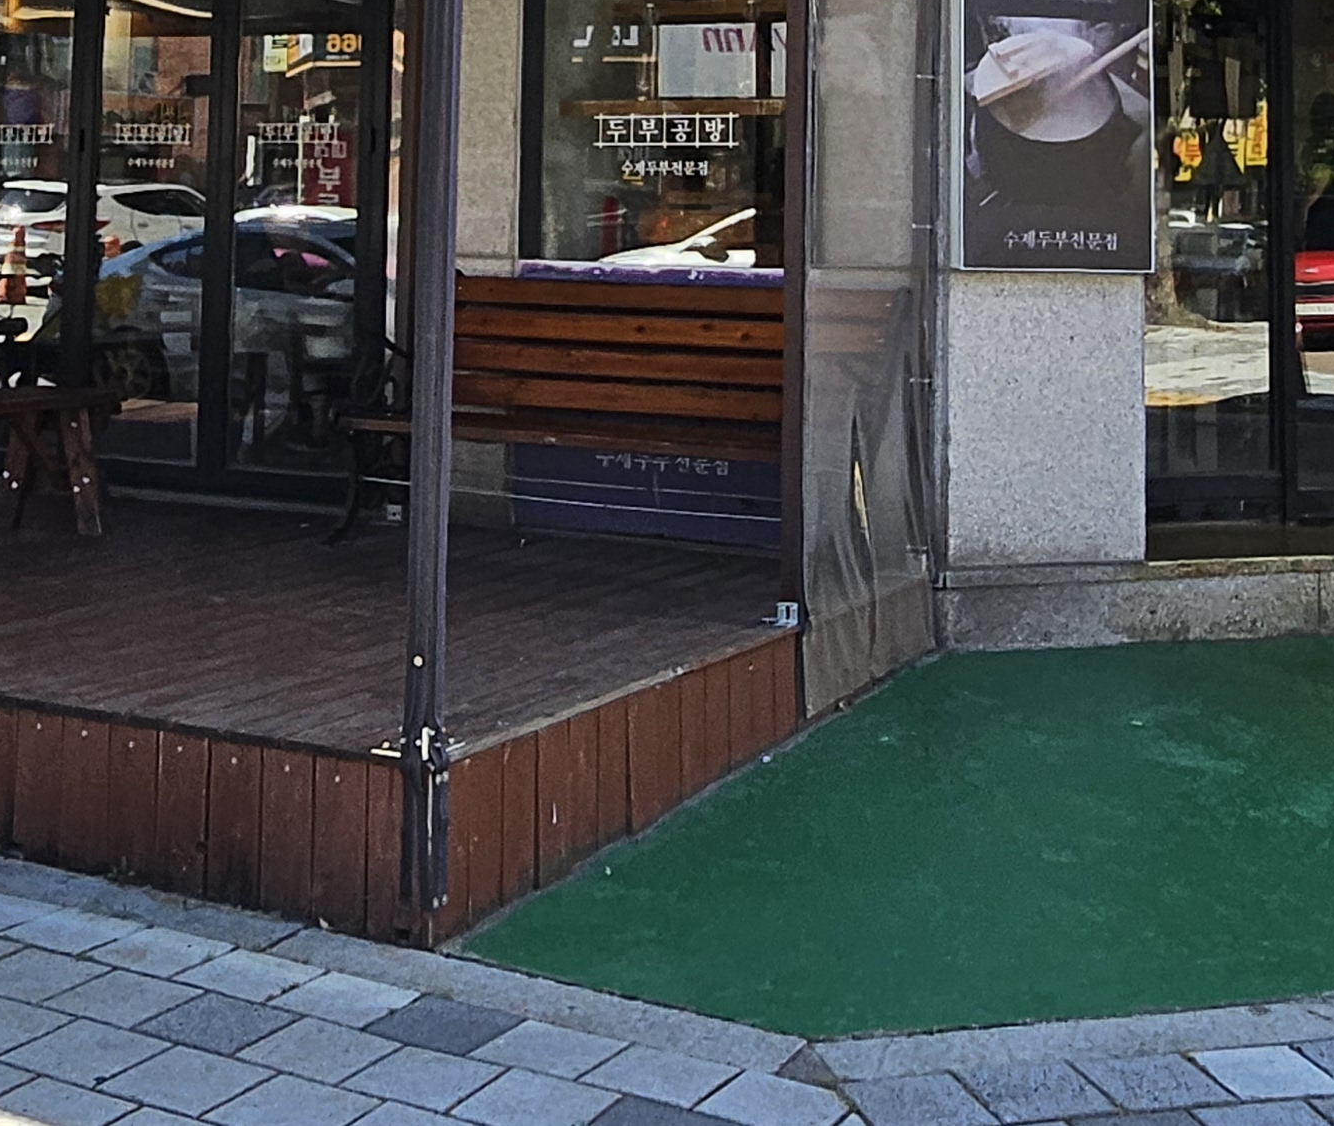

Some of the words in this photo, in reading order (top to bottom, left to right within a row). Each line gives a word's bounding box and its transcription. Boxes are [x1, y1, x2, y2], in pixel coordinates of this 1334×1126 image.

[606, 118, 726, 142] 두부공방
[621, 159, 709, 176] 수제두부전문점
[1003, 229, 1117, 251] 수제두부전문점
